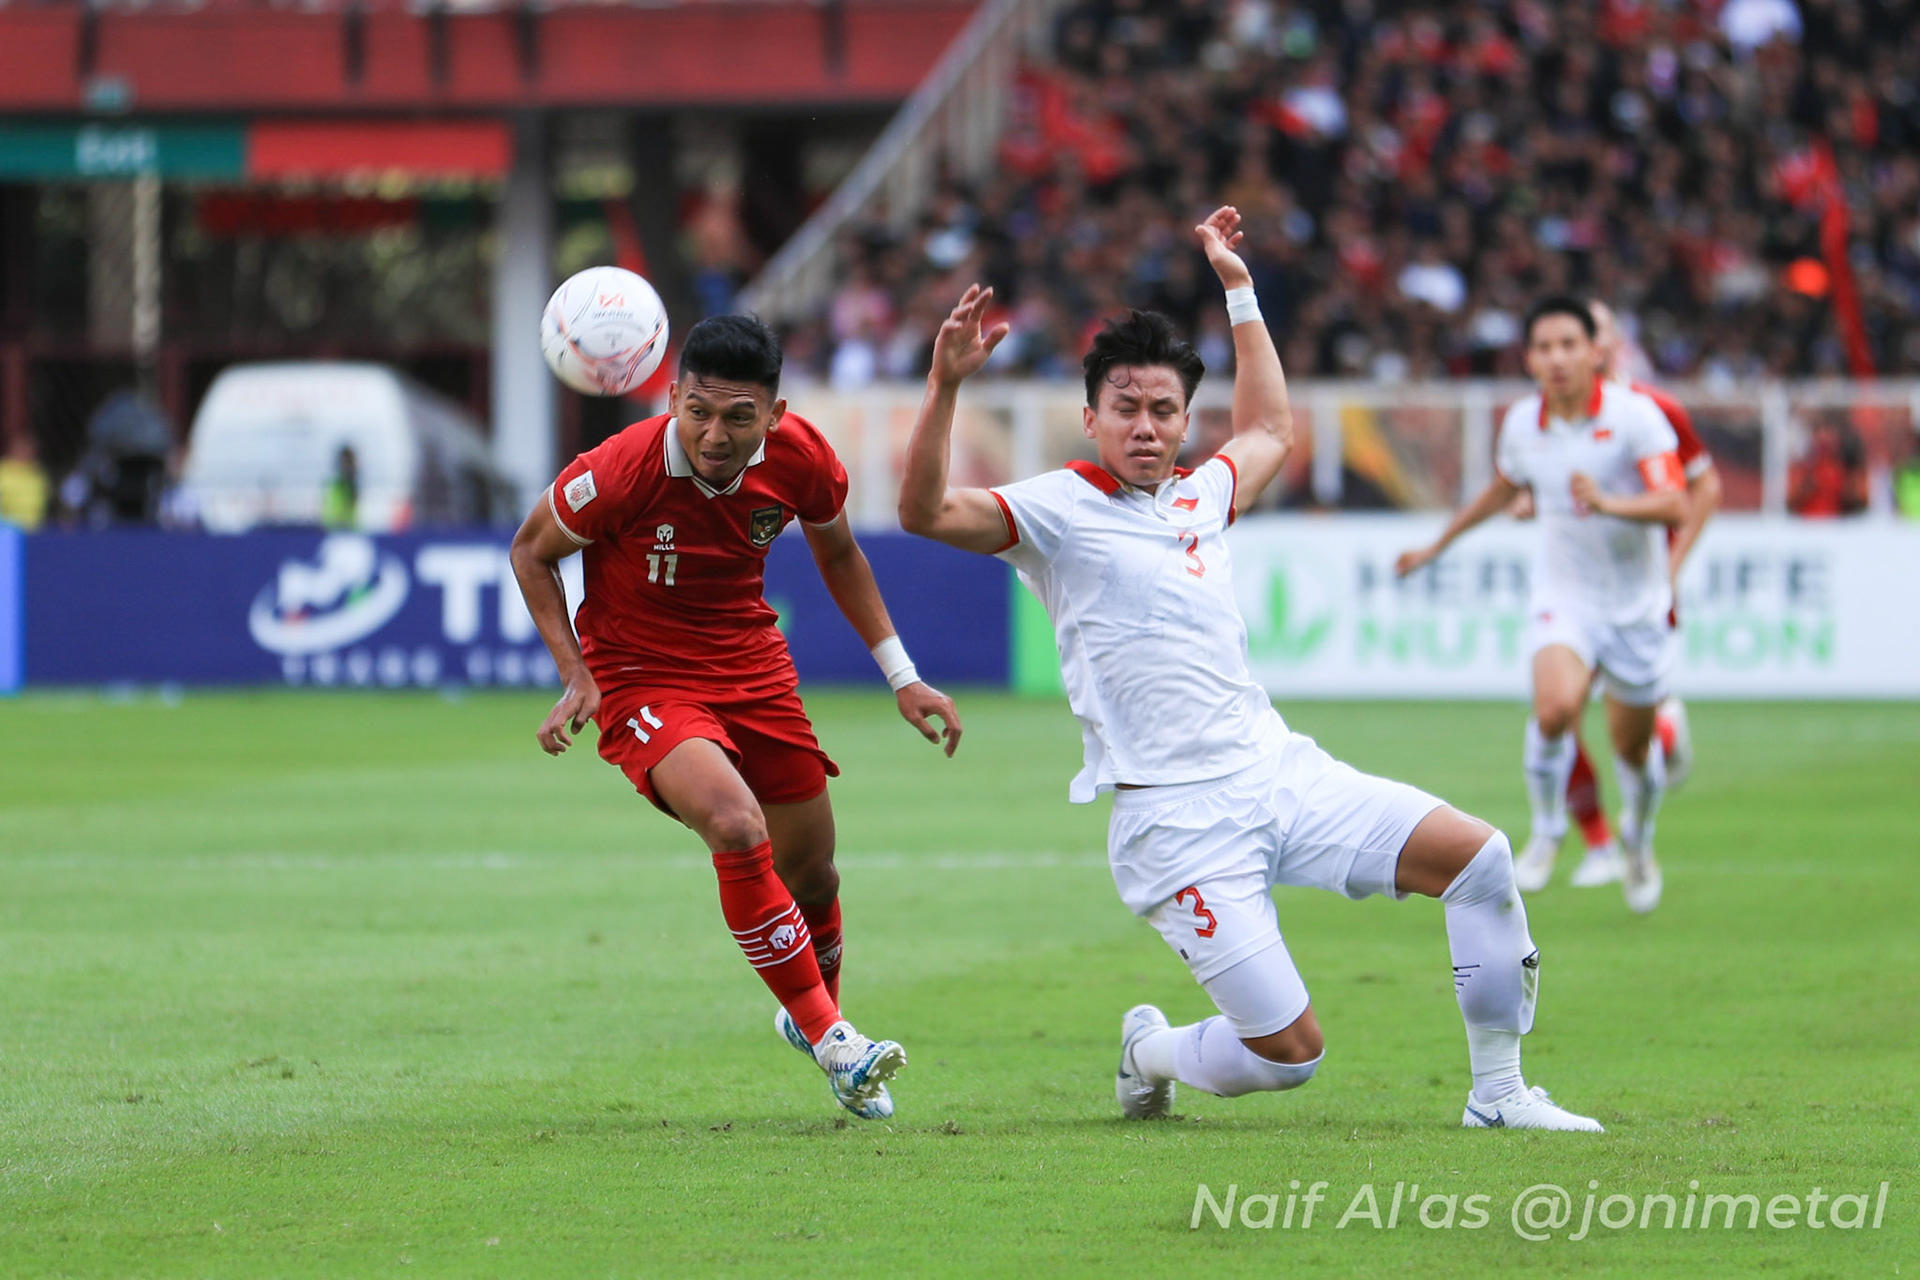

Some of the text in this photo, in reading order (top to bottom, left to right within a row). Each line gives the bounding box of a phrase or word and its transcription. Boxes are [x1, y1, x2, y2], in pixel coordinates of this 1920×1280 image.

[653, 543, 675, 551] MILLS
[1178, 531, 1206, 578] 3
[646, 553, 678, 586] 11
[626, 705, 664, 745] 11
[1174, 885, 1218, 938] 3
